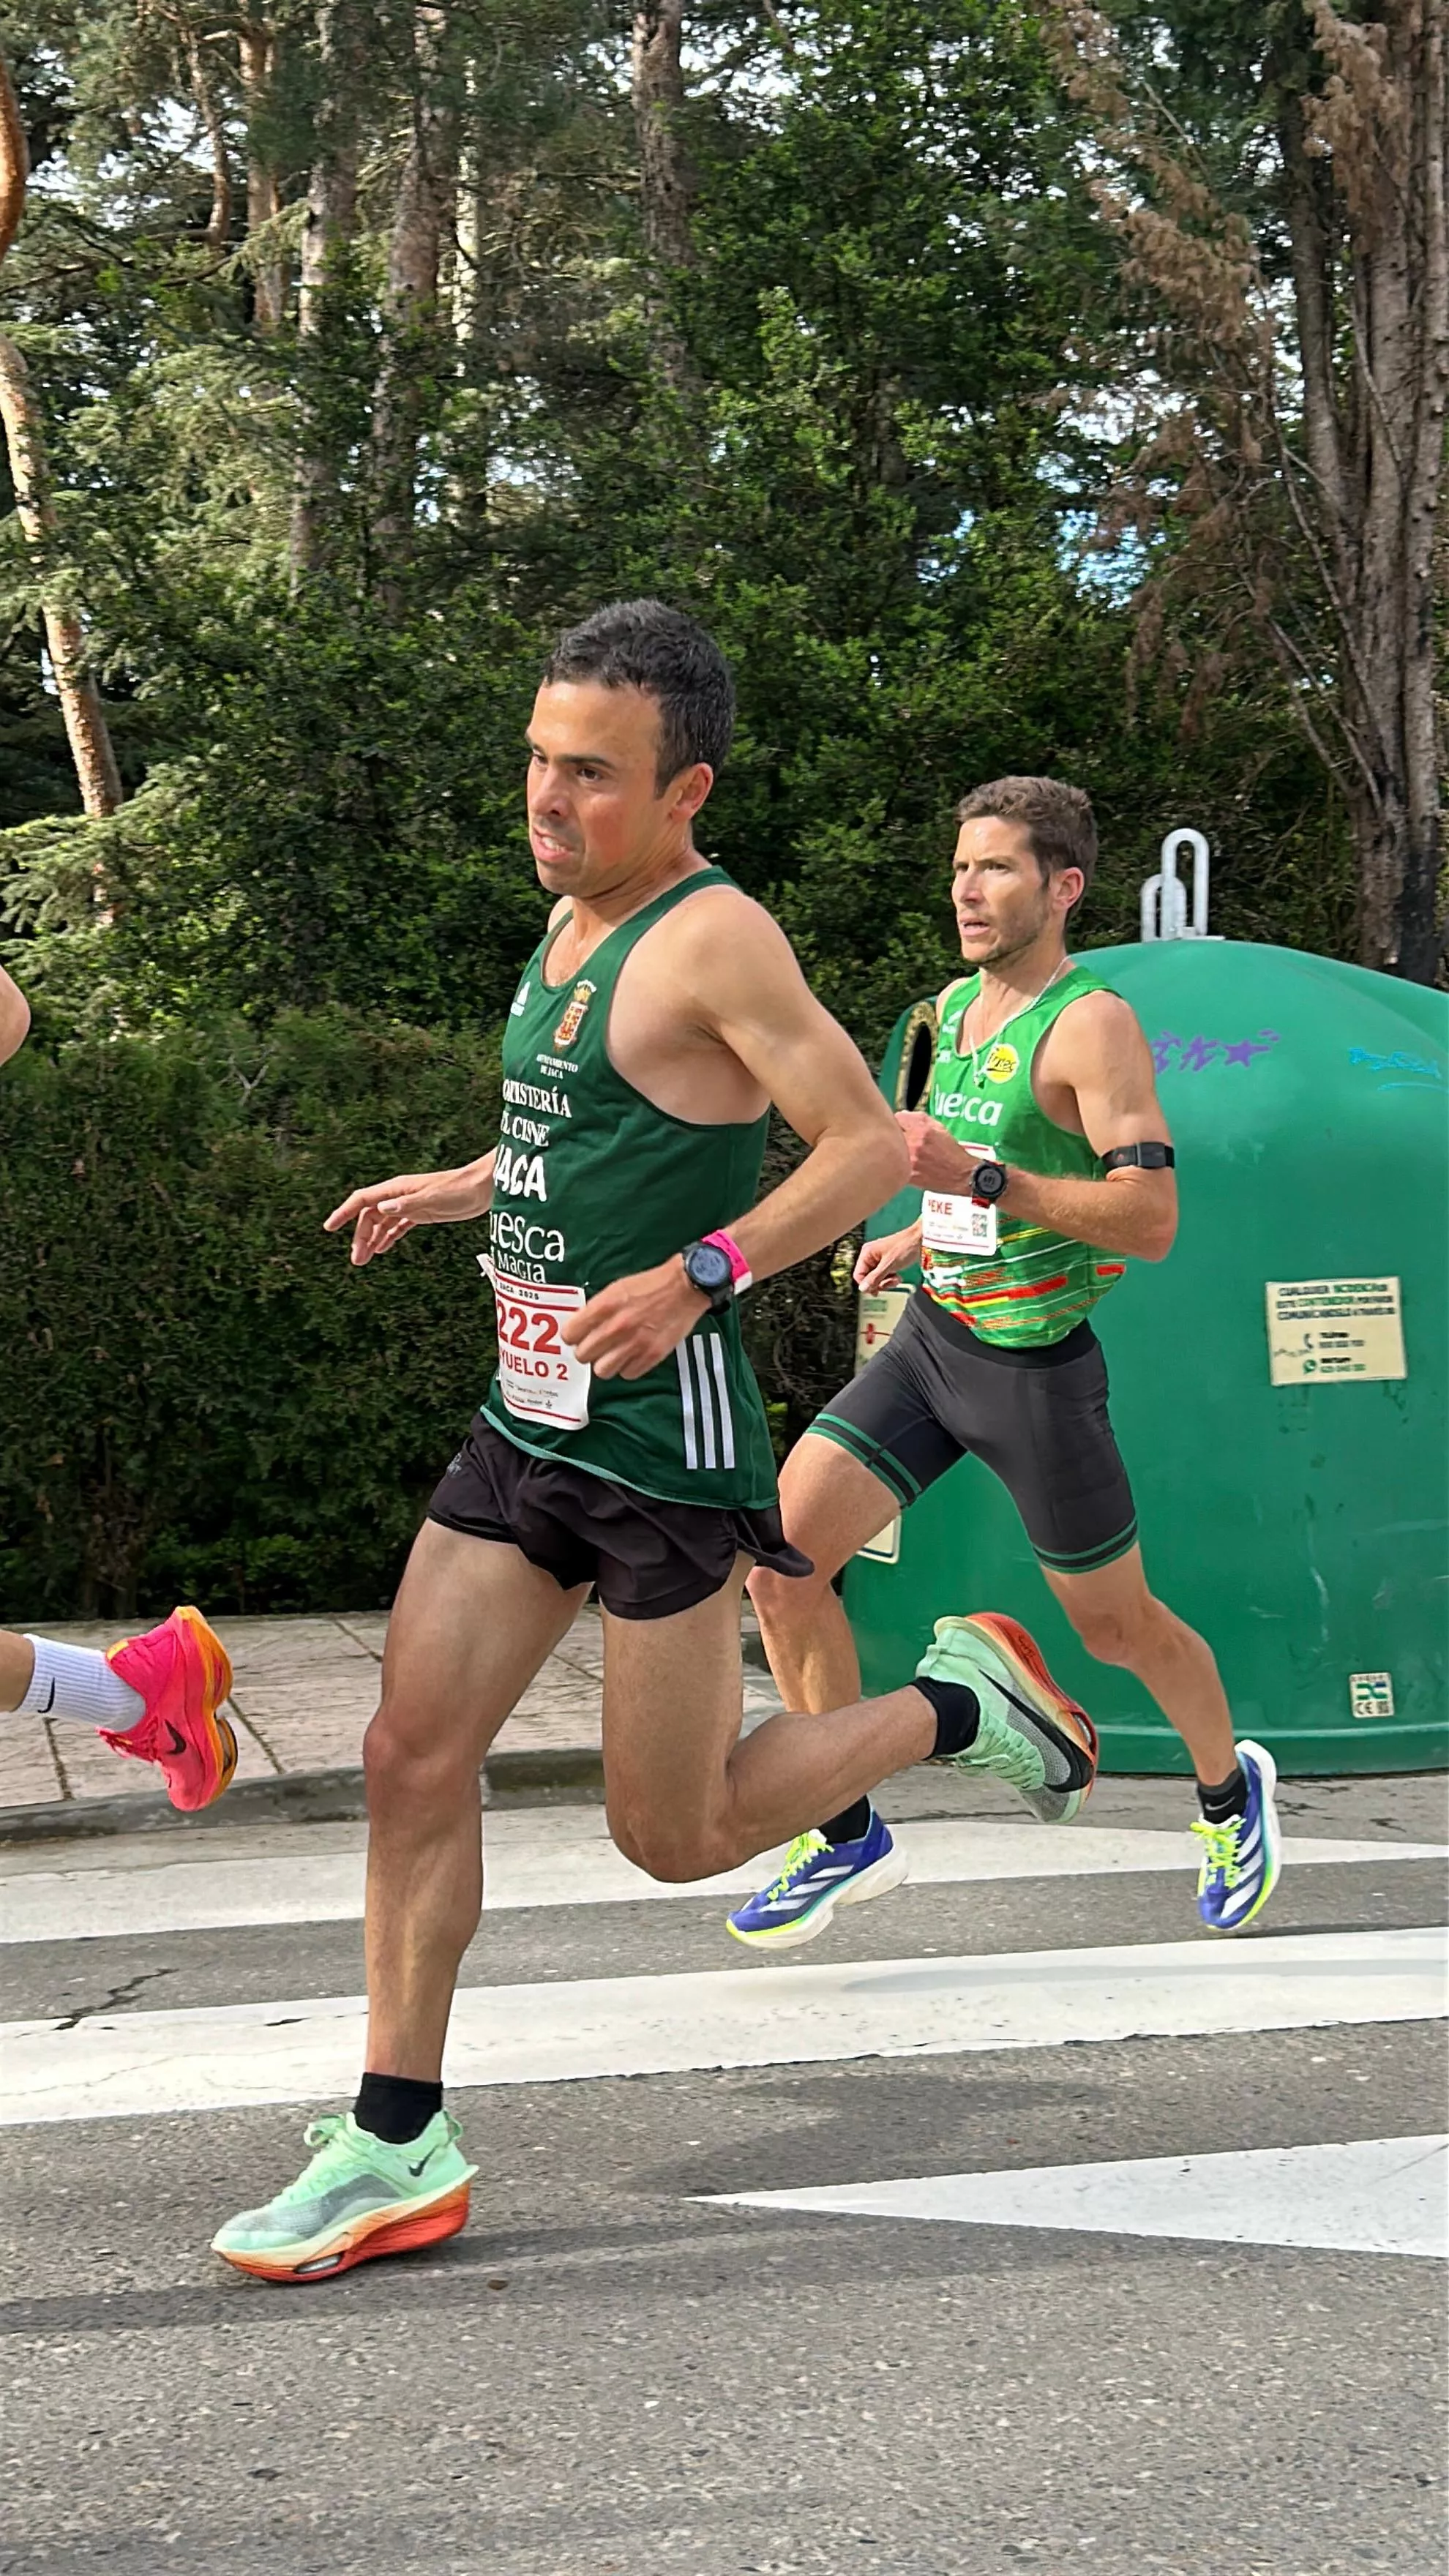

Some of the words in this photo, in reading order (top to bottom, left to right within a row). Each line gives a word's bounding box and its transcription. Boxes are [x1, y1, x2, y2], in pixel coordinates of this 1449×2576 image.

[512, 1116, 550, 1147] CINE
[519, 1289, 539, 1300] 2025
[497, 1298, 561, 1355] 222
[499, 1347, 549, 1378] YUELO
[555, 1363, 569, 1381] 2
